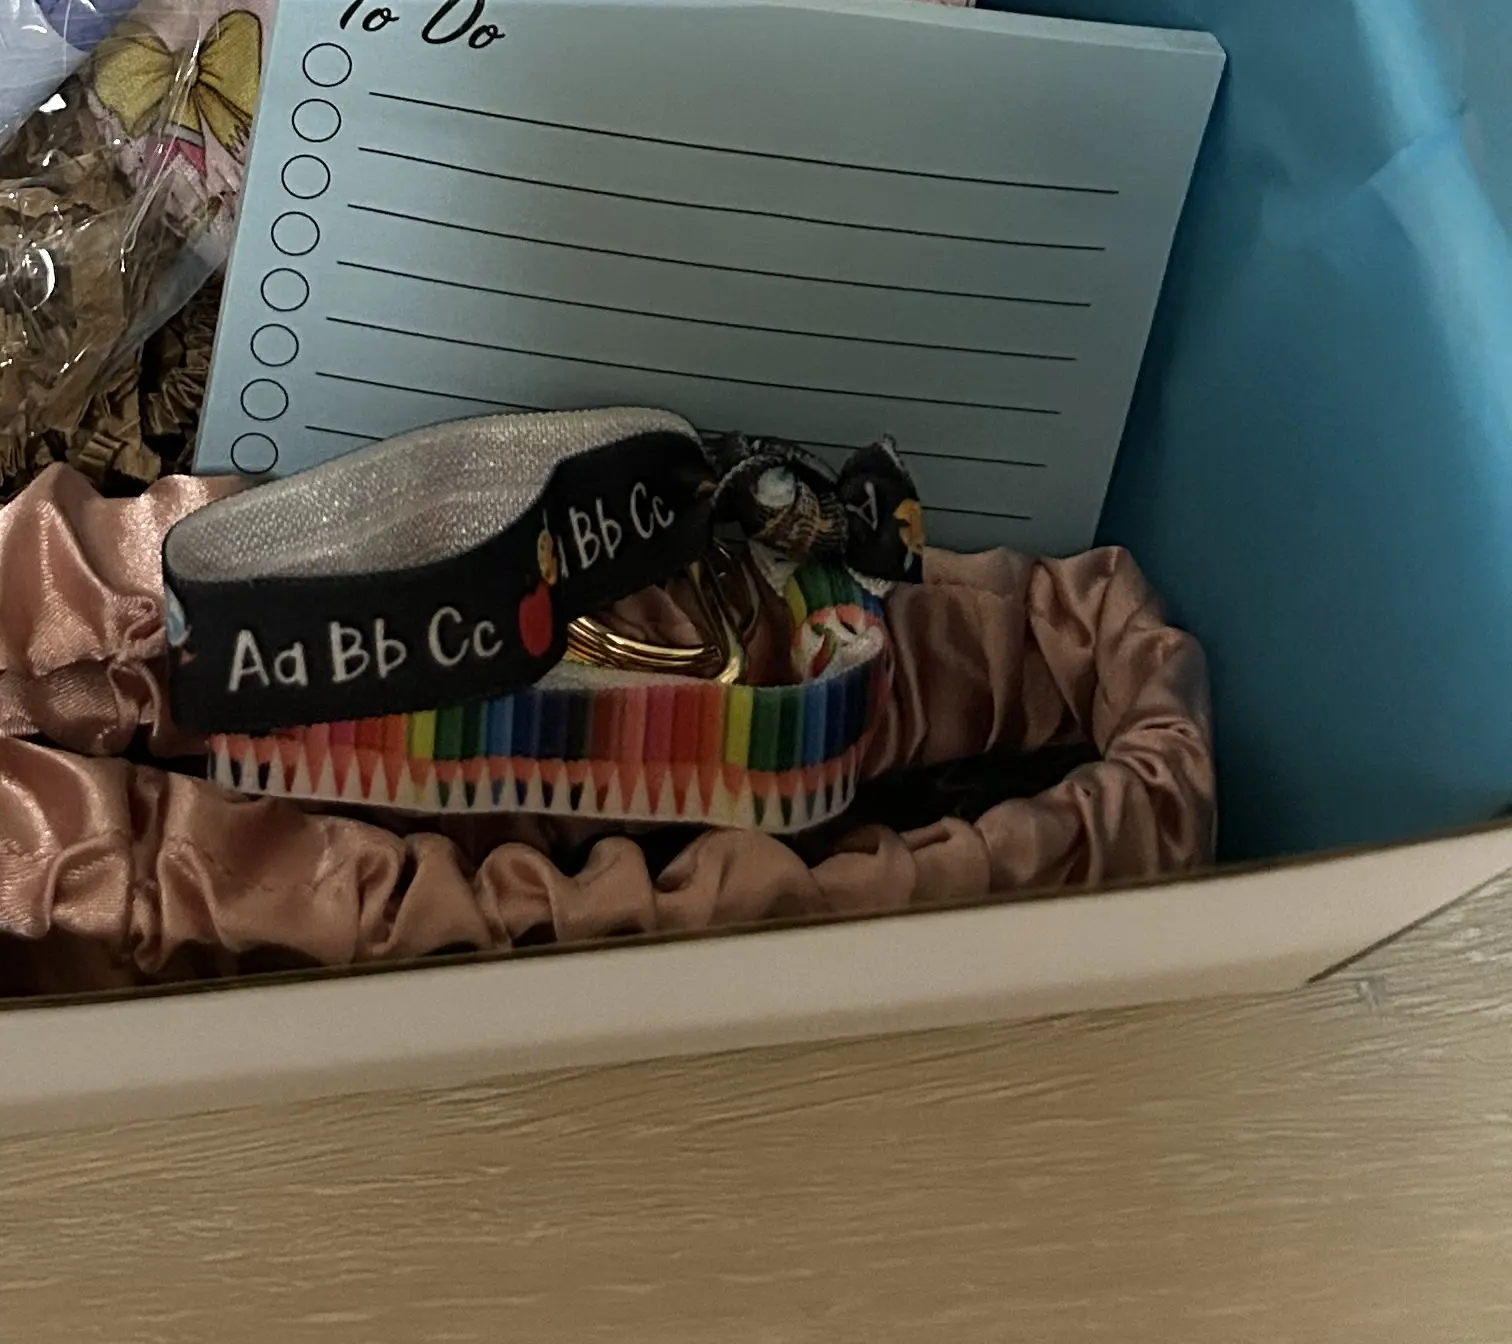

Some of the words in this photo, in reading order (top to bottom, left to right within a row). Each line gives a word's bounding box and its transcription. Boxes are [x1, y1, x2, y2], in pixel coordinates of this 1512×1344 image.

[570, 496, 622, 571] Bb
[629, 481, 675, 541] Cc
[228, 628, 309, 692] Aa
[329, 617, 407, 683] Bb
[428, 605, 503, 667] Cc
